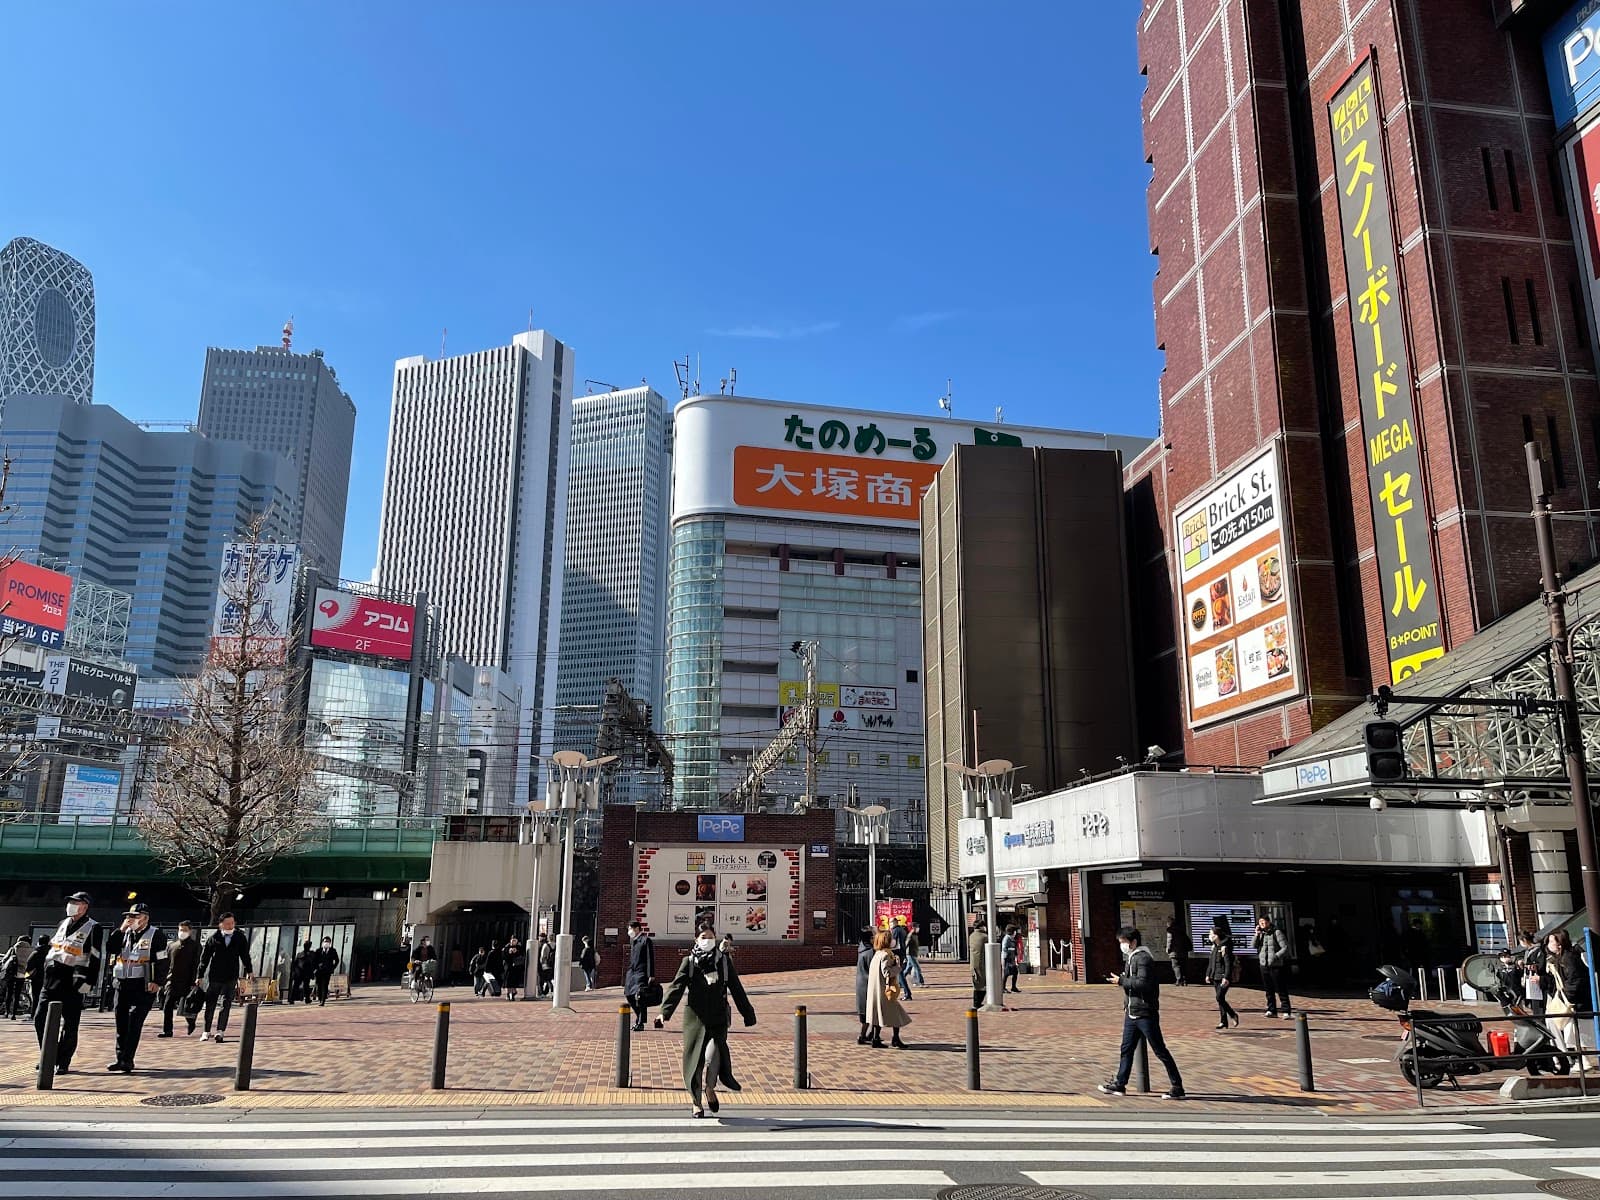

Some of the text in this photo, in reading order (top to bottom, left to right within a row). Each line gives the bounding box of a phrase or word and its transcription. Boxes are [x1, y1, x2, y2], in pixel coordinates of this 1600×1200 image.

[1344, 139, 1399, 421] スノーボード
[783, 414, 937, 461] たのめーる
[1370, 418, 1414, 467] MEGA
[755, 463, 928, 506] 大塚商
[1208, 466, 1273, 528] Brick St.
[1211, 520, 1238, 551] この先
[1379, 470, 1428, 618] セール
[8, 579, 66, 608] PROMISE
[42, 604, 63, 617] プロミス
[363, 610, 410, 633] アコム
[1, 618, 60, 645] 当ビル 6F
[355, 640, 372, 651] 2F
[48, 660, 65, 668] THE
[1300, 768, 1327, 785] PePe
[702, 820, 740, 834] PePe
[1082, 812, 1108, 838] PePe
[712, 854, 736, 864] Brick
[738, 855, 750, 864] St.
